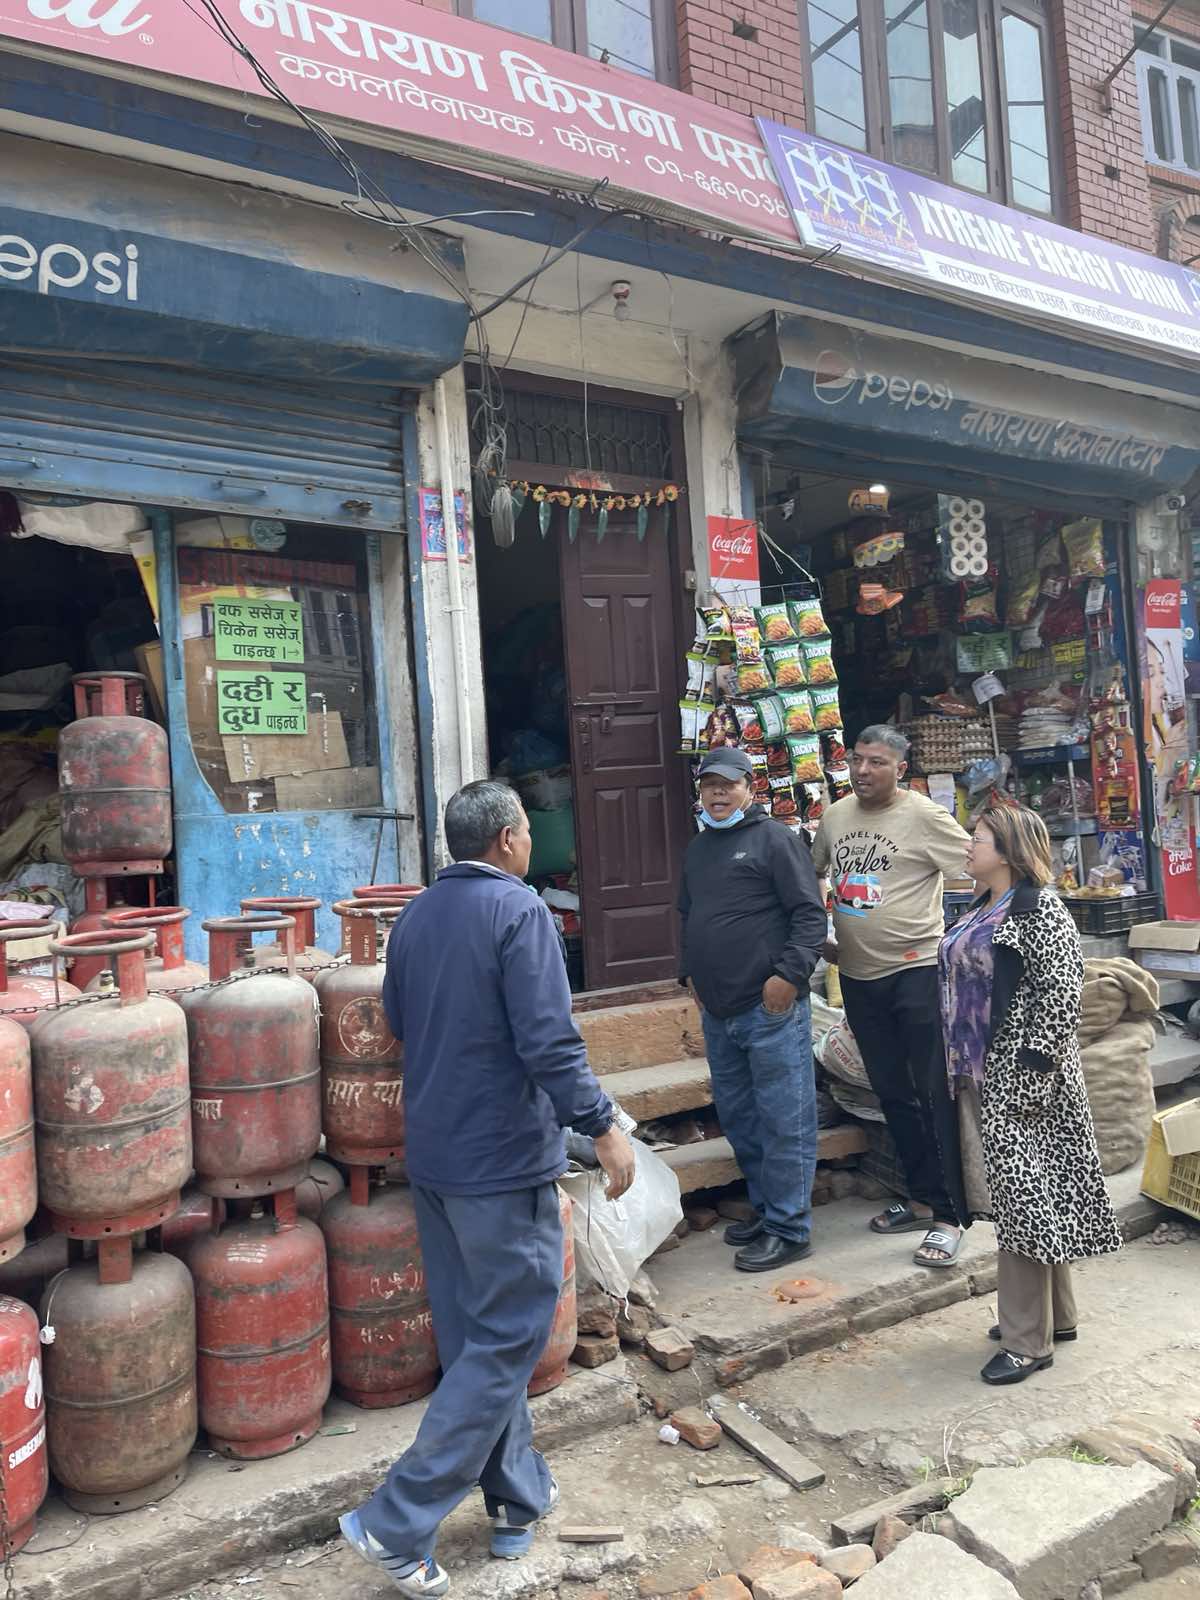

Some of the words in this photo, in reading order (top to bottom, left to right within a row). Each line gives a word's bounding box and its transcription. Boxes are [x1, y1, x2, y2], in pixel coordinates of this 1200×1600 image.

[239, 0, 488, 91] नारायण
[500, 49, 684, 150] किराना
[908, 191, 1031, 266] XTREME
[1022, 231, 1122, 294] ENERGY
[1115, 262, 1193, 316] DRINK
[858, 372, 954, 411] pepsi
[218, 620, 258, 638] चिकेन
[289, 608, 299, 621] र
[222, 674, 274, 703] दही
[283, 683, 302, 702] र
[834, 831, 870, 849] TRAVEL
[873, 832, 899, 854] WITH
[833, 843, 893, 878] Surfer
[1169, 861, 1192, 876] Coke
